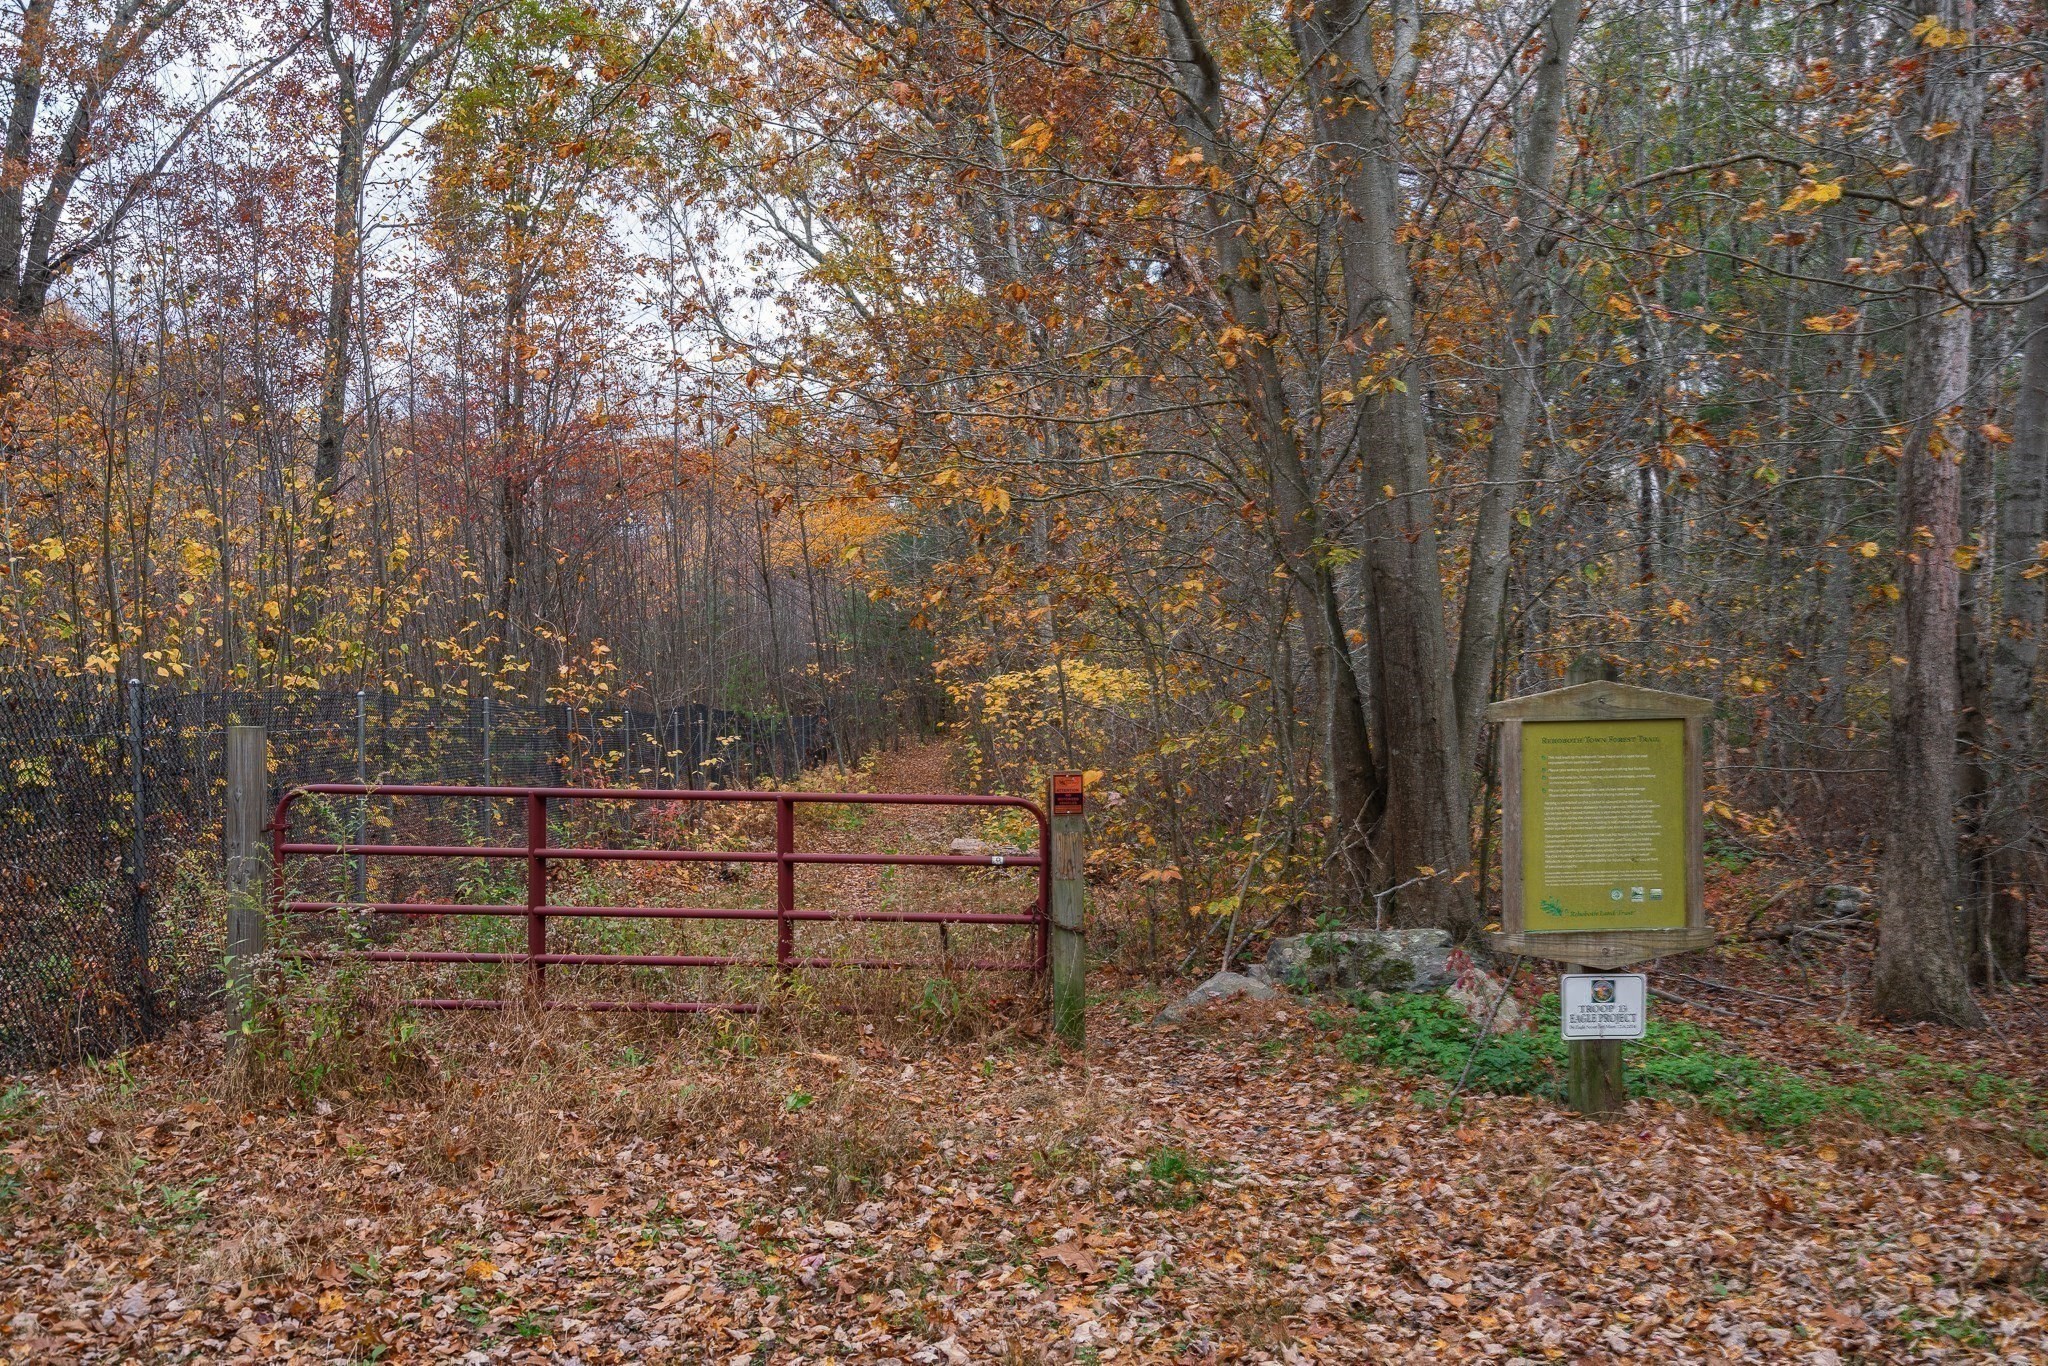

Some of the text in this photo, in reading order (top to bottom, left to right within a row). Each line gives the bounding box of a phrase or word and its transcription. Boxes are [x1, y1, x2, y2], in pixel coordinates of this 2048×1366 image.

[1584, 736, 1607, 744] TOWN
[1608, 735, 1636, 743] FOREST
[1638, 735, 1660, 743] TRAIL
[1577, 1004, 1615, 1013] TROOP
[1569, 1013, 1637, 1024] EAGLE PROJECT
